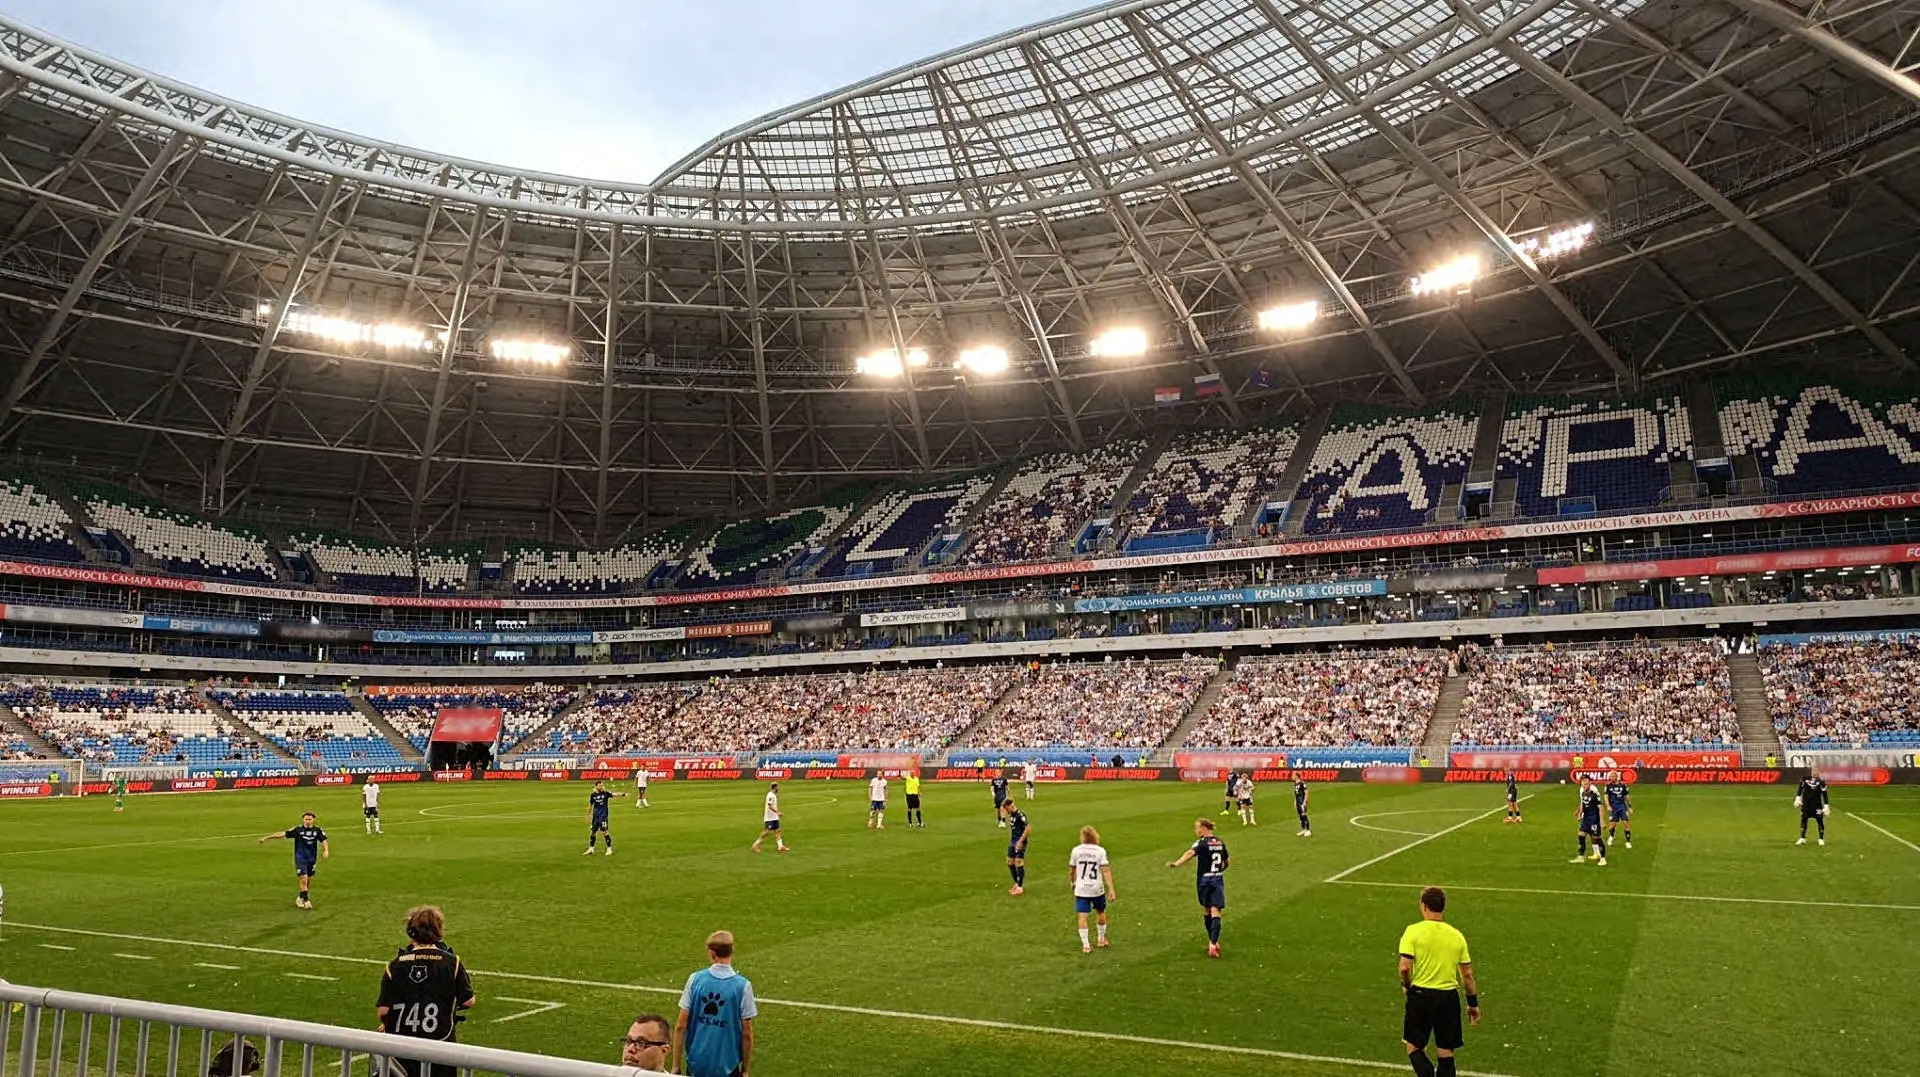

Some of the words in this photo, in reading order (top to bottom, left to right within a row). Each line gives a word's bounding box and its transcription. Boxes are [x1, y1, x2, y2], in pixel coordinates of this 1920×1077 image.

[1525, 518, 1625, 535] СОЛИДАРНОСТЬ
[1630, 513, 1684, 527] САМАРА
[1689, 509, 1730, 521] АРЕНА
[1109, 555, 1182, 567] СОЛИДАРНОСТЬ
[1185, 551, 1226, 561] САМАРА
[1230, 548, 1260, 557] АРЕНА
[24, 564, 108, 581] СОЛИДАРНОСТЬ
[112, 574, 151, 586] САМАРА
[154, 577, 184, 588] АРЕНА
[1011, 566, 1048, 576] САМАРА
[1048, 563, 1075, 573] АРЕНА
[220, 586, 287, 598] СОЛИДАРНОСТЬ
[329, 594, 356, 602] АРЕНА
[723, 591, 750, 600] САМАРА
[1255, 587, 1304, 600] КРЫЛЬЯ
[1321, 583, 1372, 596] СОВЕТОВ
[463, 599, 498, 608] САМАРА
[1121, 597, 1182, 608] СОЛИДАРНОСТЬ
[1184, 594, 1216, 603] САМАРА
[1218, 592, 1243, 601] АРЕНА
[900, 611, 961, 622] ТРАНССТРОЙ
[974, 604, 1020, 618] COFFEE
[1024, 603, 1050, 615] LIKE
[170, 618, 258, 637] ВЕРТИКАЛЬ
[393, 685, 469, 695] СОЛИДАРНОСТЬ
[472, 685, 496, 695] БАНК
[523, 684, 565, 695] СЕКТОР
[1702, 755, 1730, 763] БАНК
[318, 776, 344, 784] WINLINE
[1252, 769, 1290, 781] ДЕЛАЕТ
[1444, 770, 1489, 782] ДЕЛАЕТ
[1489, 770, 1546, 783] РАНИЦУ
[1665, 770, 1715, 784] ДЕЛАЕТ
[1716, 770, 1780, 784] РАЗНИЦУ
[1, 785, 40, 796] WINLINE
[175, 780, 207, 789] WINLINE
[1210, 852, 1222, 873] 2
[1079, 861, 1098, 880] 73
[393, 1002, 440, 1033] 748
